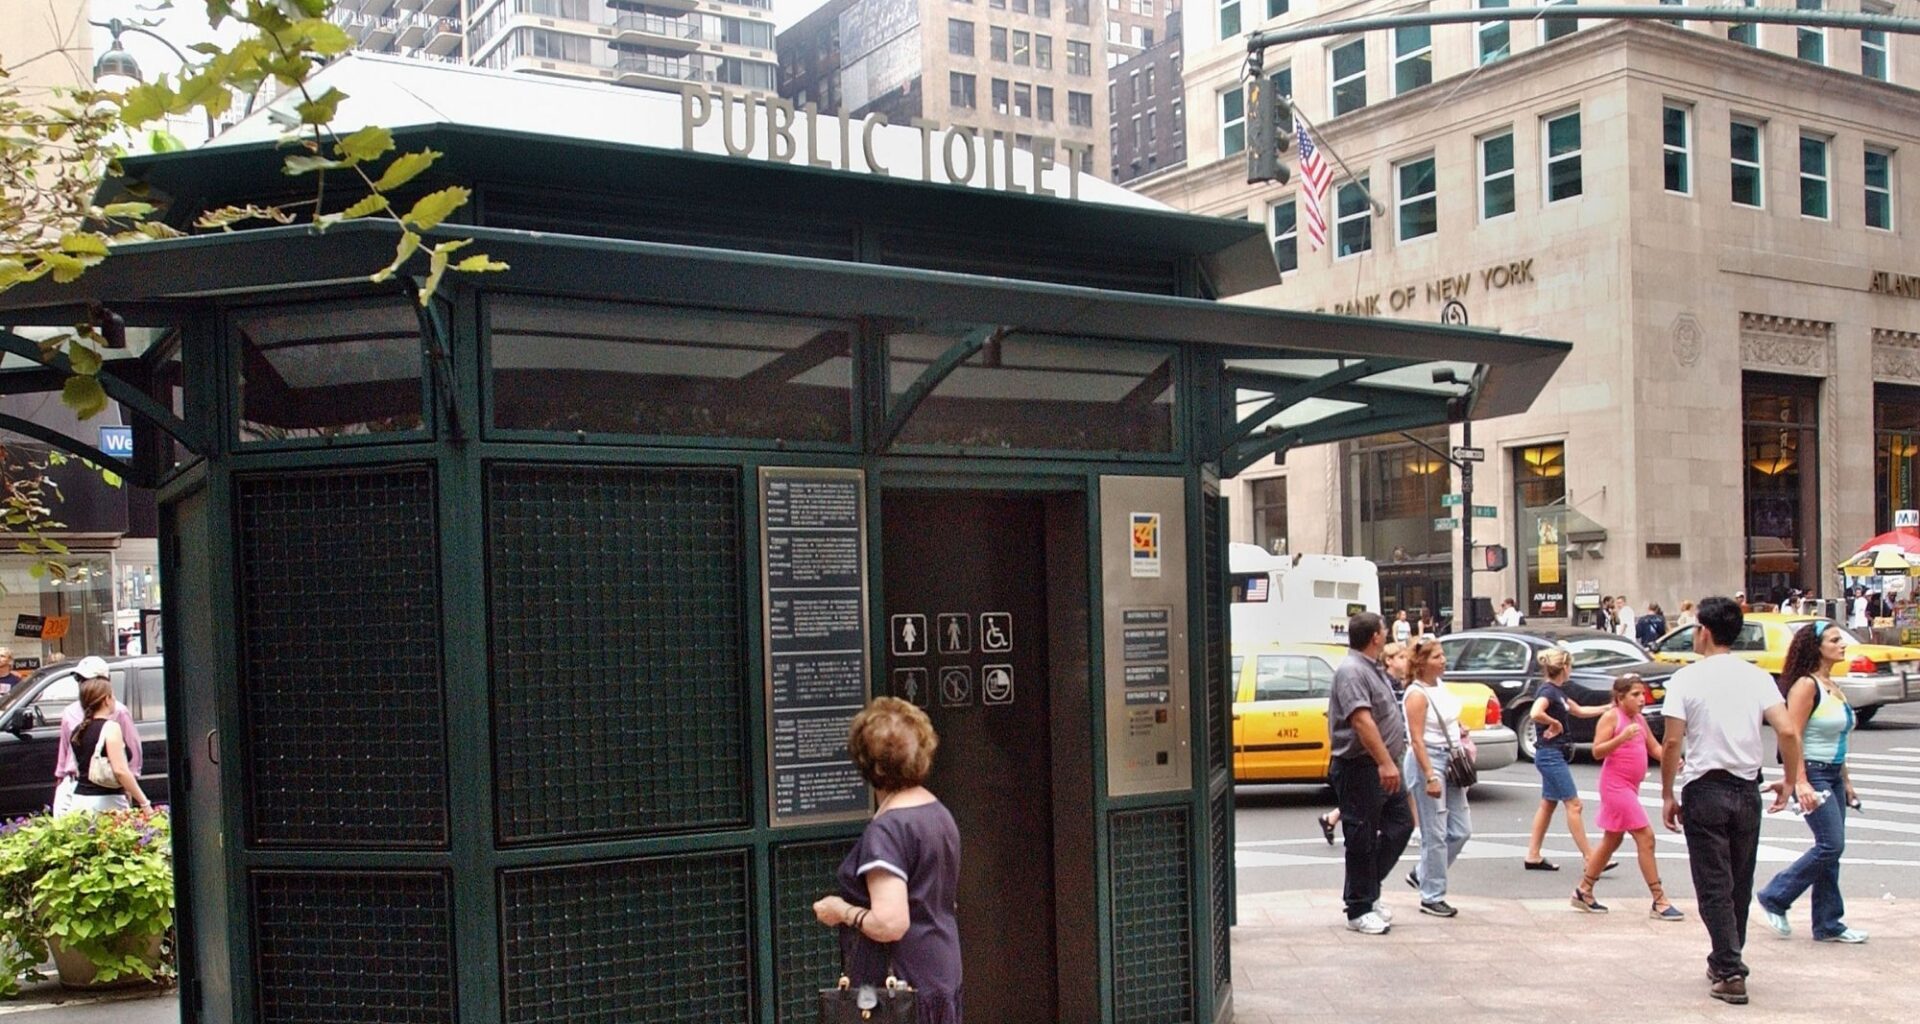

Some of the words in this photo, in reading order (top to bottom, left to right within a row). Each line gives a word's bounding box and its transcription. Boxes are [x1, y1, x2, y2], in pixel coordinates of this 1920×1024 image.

[681, 84, 889, 175] PUBLIC
[911, 117, 1093, 200] TOILET
[1334, 293, 1381, 316] BANK
[1390, 286, 1417, 312] OF
[1426, 273, 1471, 304] NEW
[1479, 258, 1535, 290] YORK
[1547, 593, 1563, 601] inside
[1277, 728, 1299, 738] 4X12
